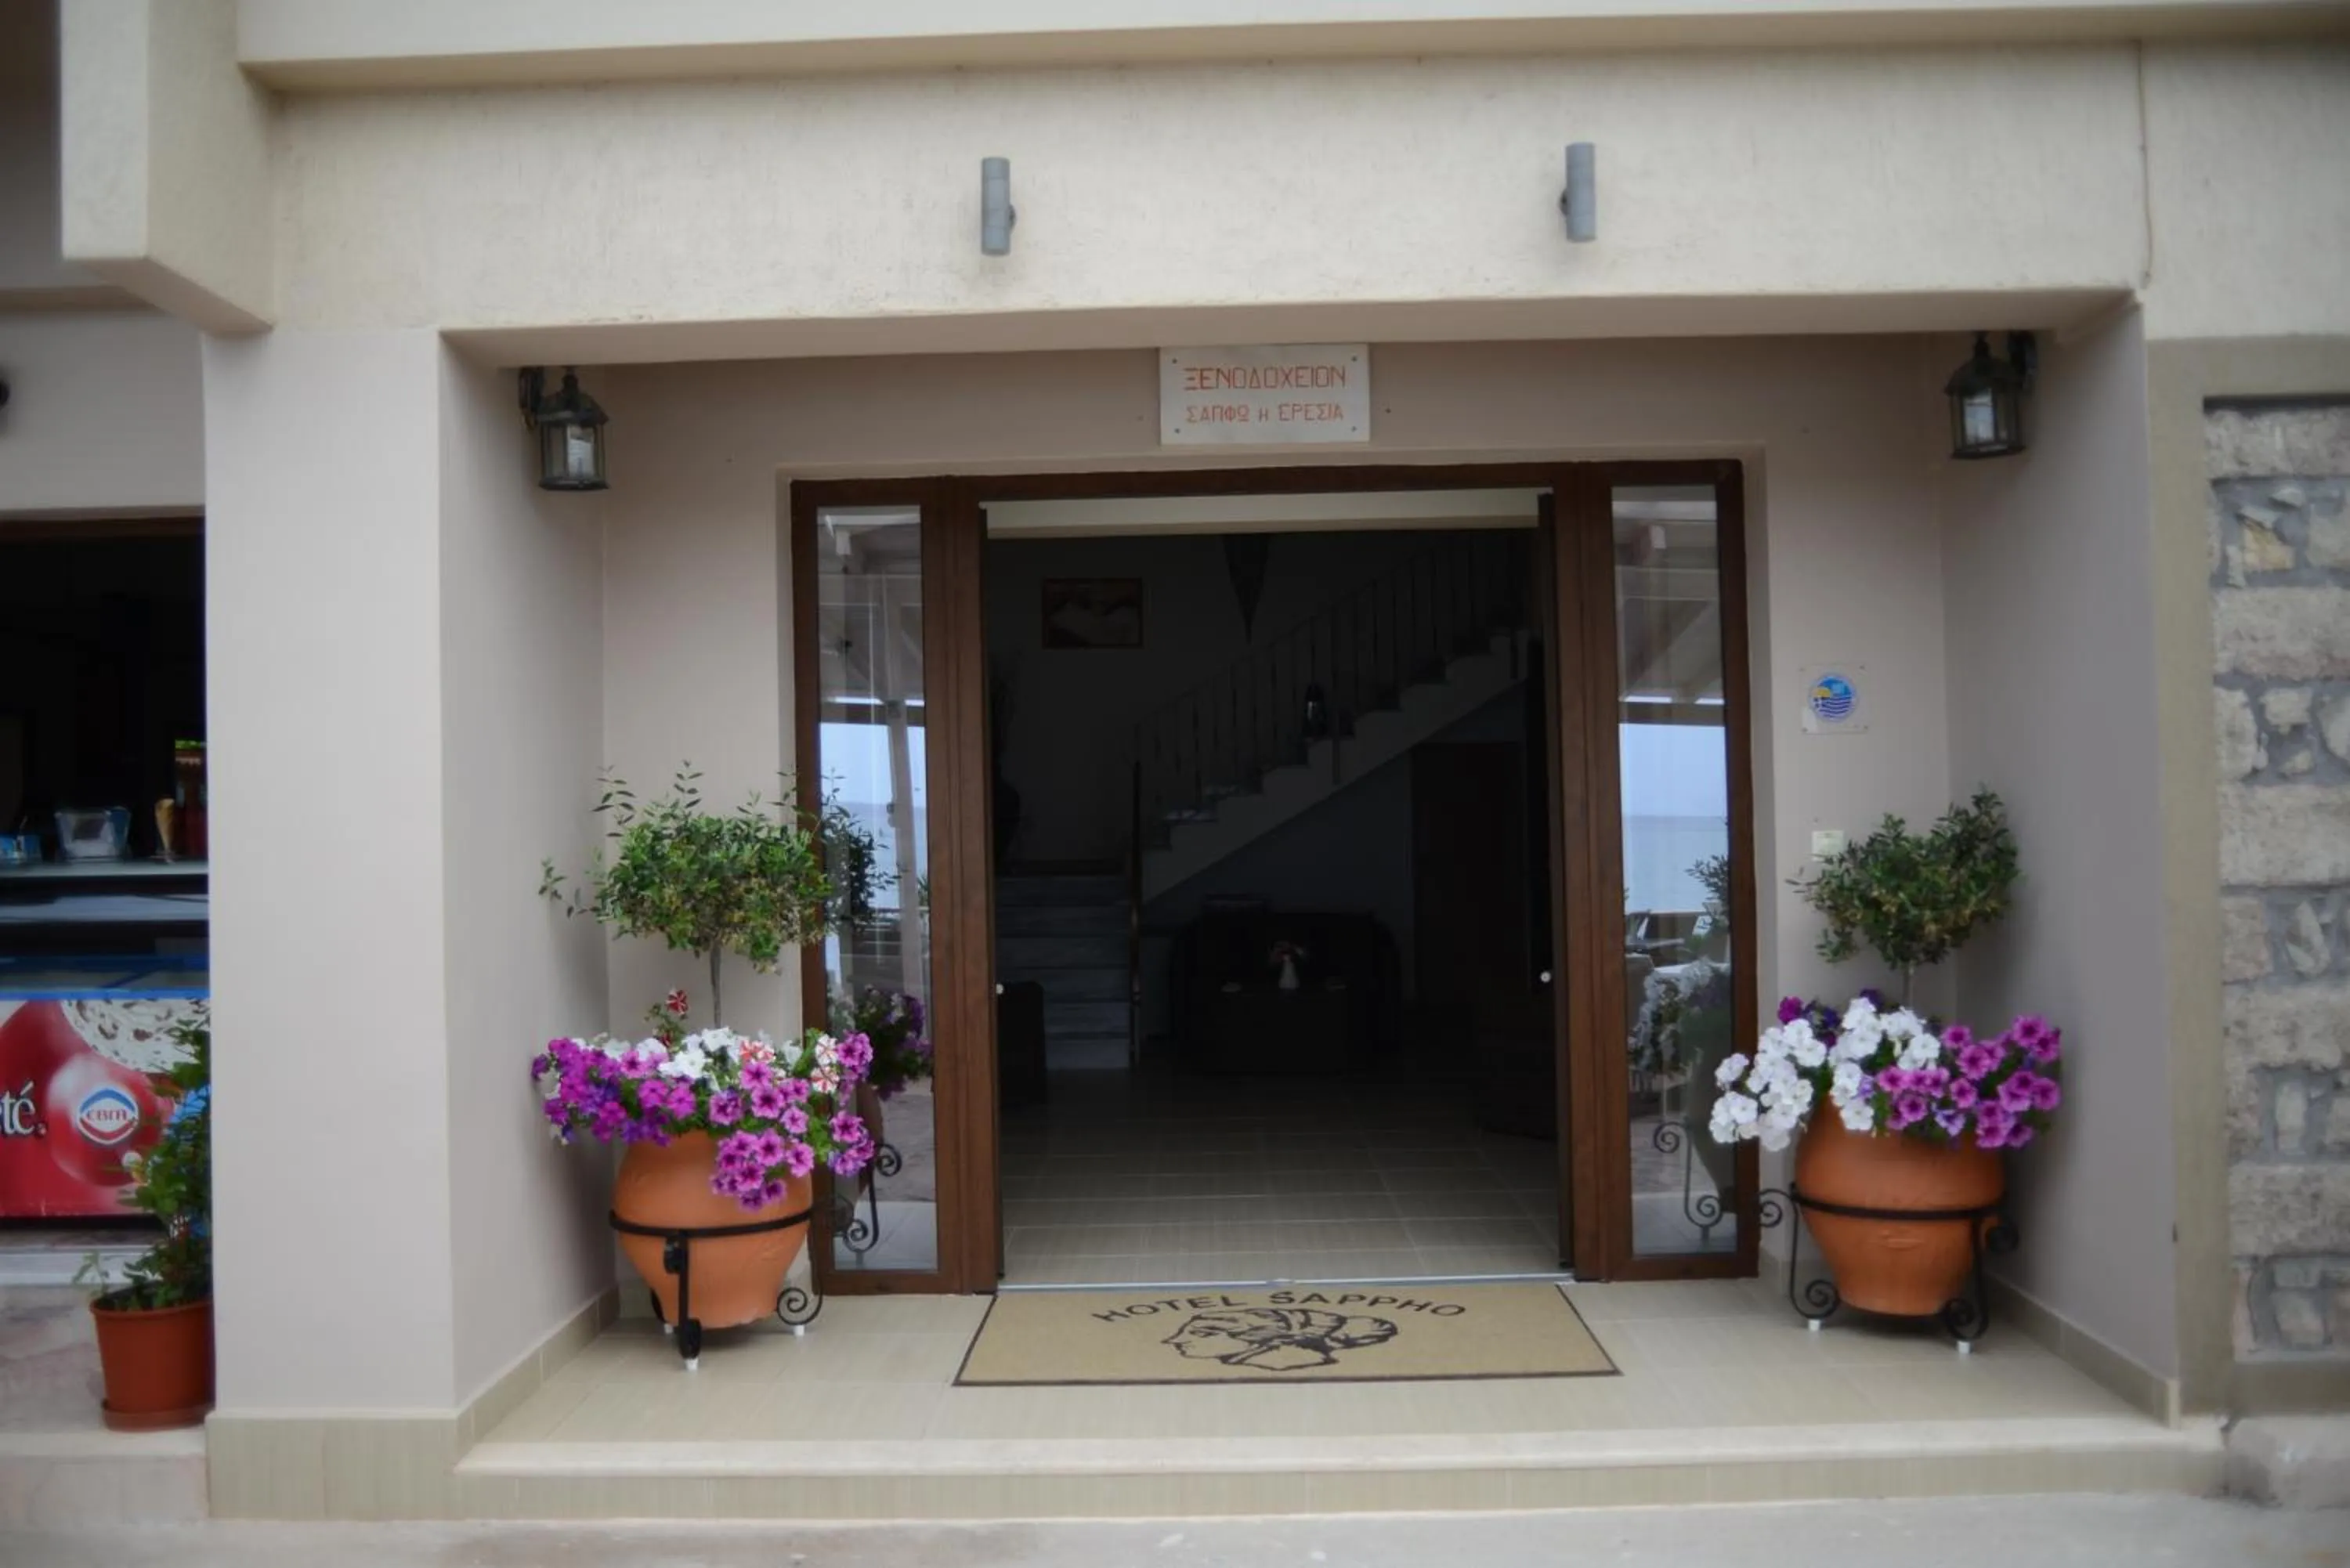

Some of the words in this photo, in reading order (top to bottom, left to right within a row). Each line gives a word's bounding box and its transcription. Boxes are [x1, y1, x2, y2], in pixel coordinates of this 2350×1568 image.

[1184, 365, 1345, 390] ΞΕΝΟΔΟΧΕΙΟΝ
[1185, 405, 1250, 424] ΣΑΠΦΩ
[1278, 403, 1344, 421] ΕΡΕΣΙΑ
[1091, 1295, 1249, 1322] HOTEL
[1269, 1292, 1466, 1317] SAPPHO
